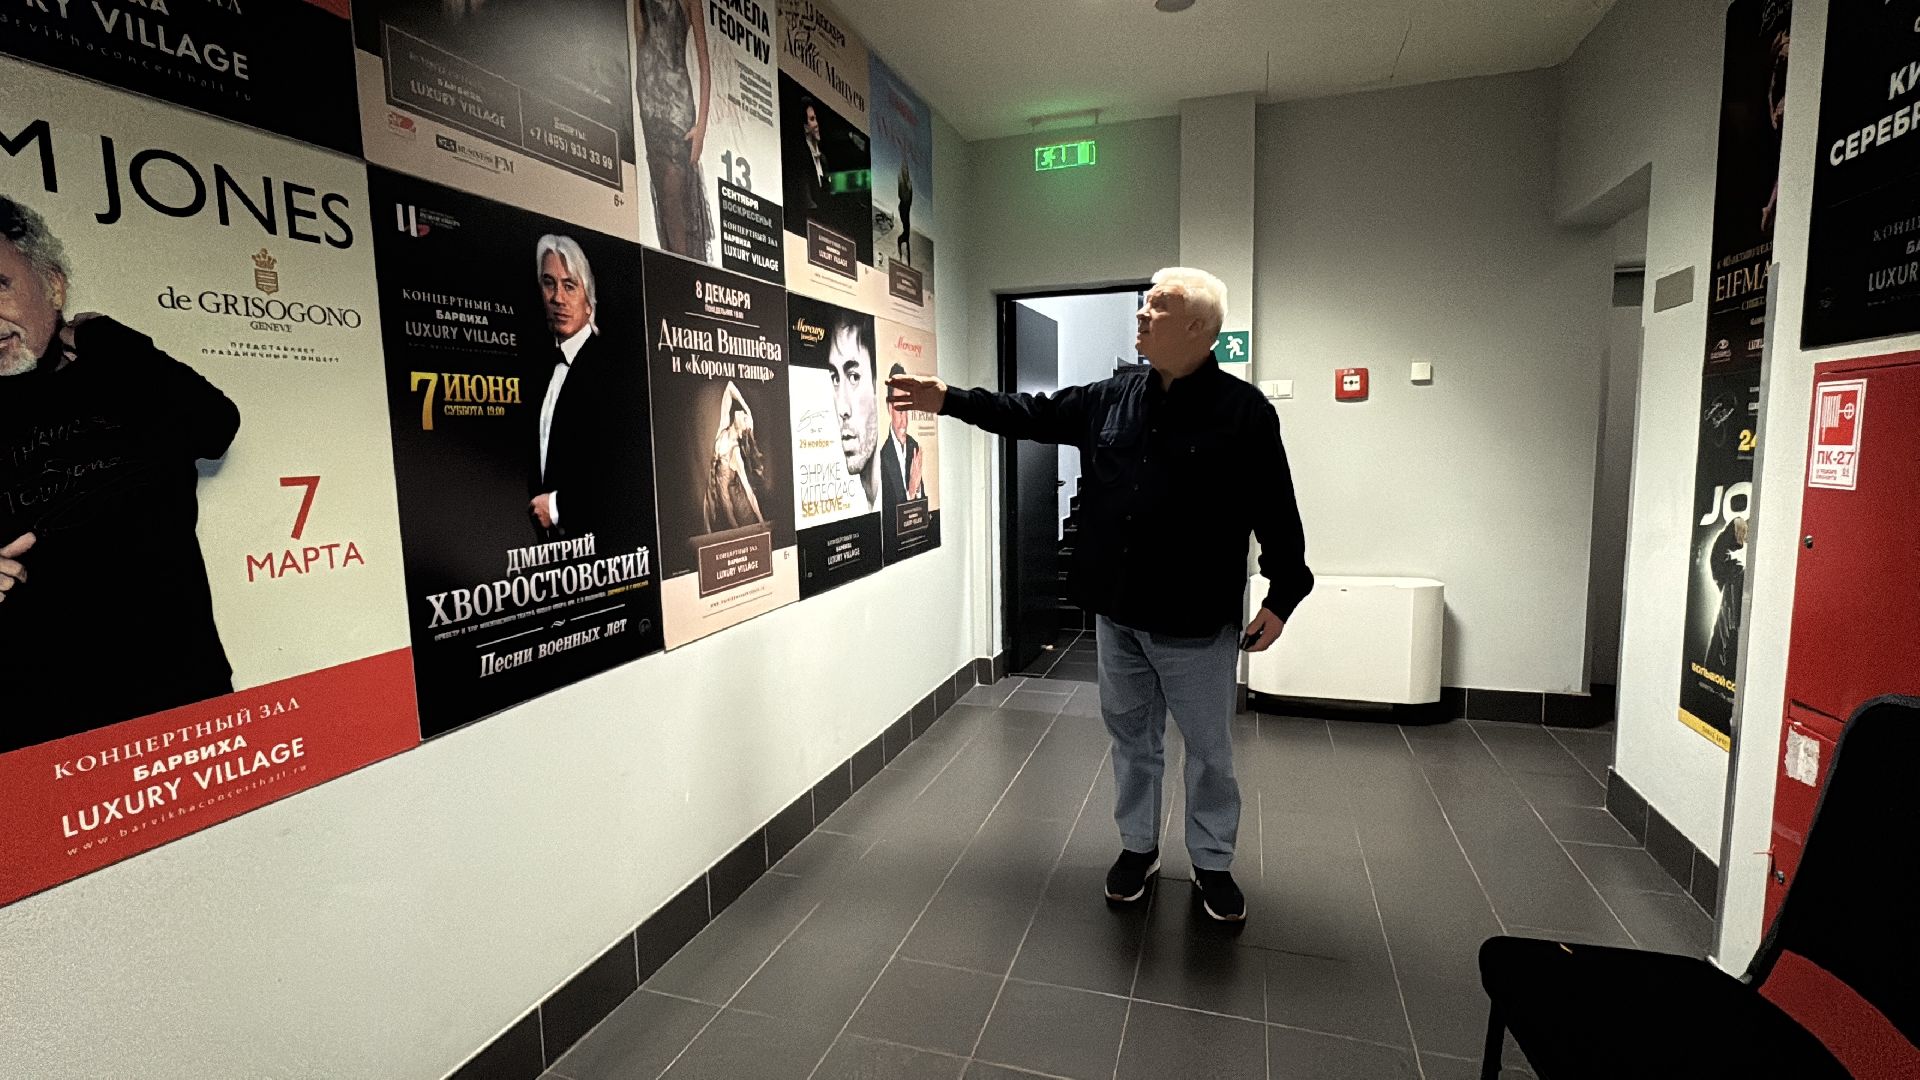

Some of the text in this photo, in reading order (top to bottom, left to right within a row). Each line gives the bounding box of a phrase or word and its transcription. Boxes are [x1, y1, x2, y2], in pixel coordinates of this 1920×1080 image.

[92, 0, 250, 81] VILLAGE
[709, 0, 771, 65] ГЕОРГИУ
[410, 79, 456, 107] LUXURY
[721, 149, 752, 192] 13
[94, 134, 355, 251] JONES
[721, 185, 759, 211] СЕНТЯБРЯ
[722, 199, 772, 229] ВОСКРЕСЕНЬЕ
[723, 243, 779, 272] LUXURY VILLAGE
[157, 286, 362, 329] de GRISOGONO
[402, 288, 515, 316] КОНЦЕРТНЫЙ ЗАЛ
[695, 280, 752, 310] 8 ДЕКАБРЯ
[249, 320, 293, 333] GENEVE
[405, 320, 518, 347] LUXURY VILLAGE
[435, 309, 490, 326] БАРВИХА
[658, 318, 782, 362] Диана Вишнёва
[672, 353, 775, 385] и «Короли танца»
[410, 370, 522, 431] 7 ИЮНЯ
[443, 404, 484, 417] СУББОТА
[800, 462, 841, 485] ЭНРИКЕ
[1816, 450, 1856, 465] ПК-27
[279, 475, 322, 541] 7
[246, 541, 365, 583] МАРТА
[506, 532, 597, 578] ДМИТРИЙ
[716, 560, 759, 580] LUXURY VILLAGE
[426, 545, 650, 629] ХВОРОСТОВСКИЙ
[479, 646, 534, 679] Песни
[537, 624, 601, 660] военных
[603, 618, 628, 639] лет
[54, 697, 300, 781] КОНЦЕРТНЫЙ ЗАЛ
[132, 734, 248, 782] БАРВИХА
[61, 737, 305, 838] LUXURY VILLAGE
